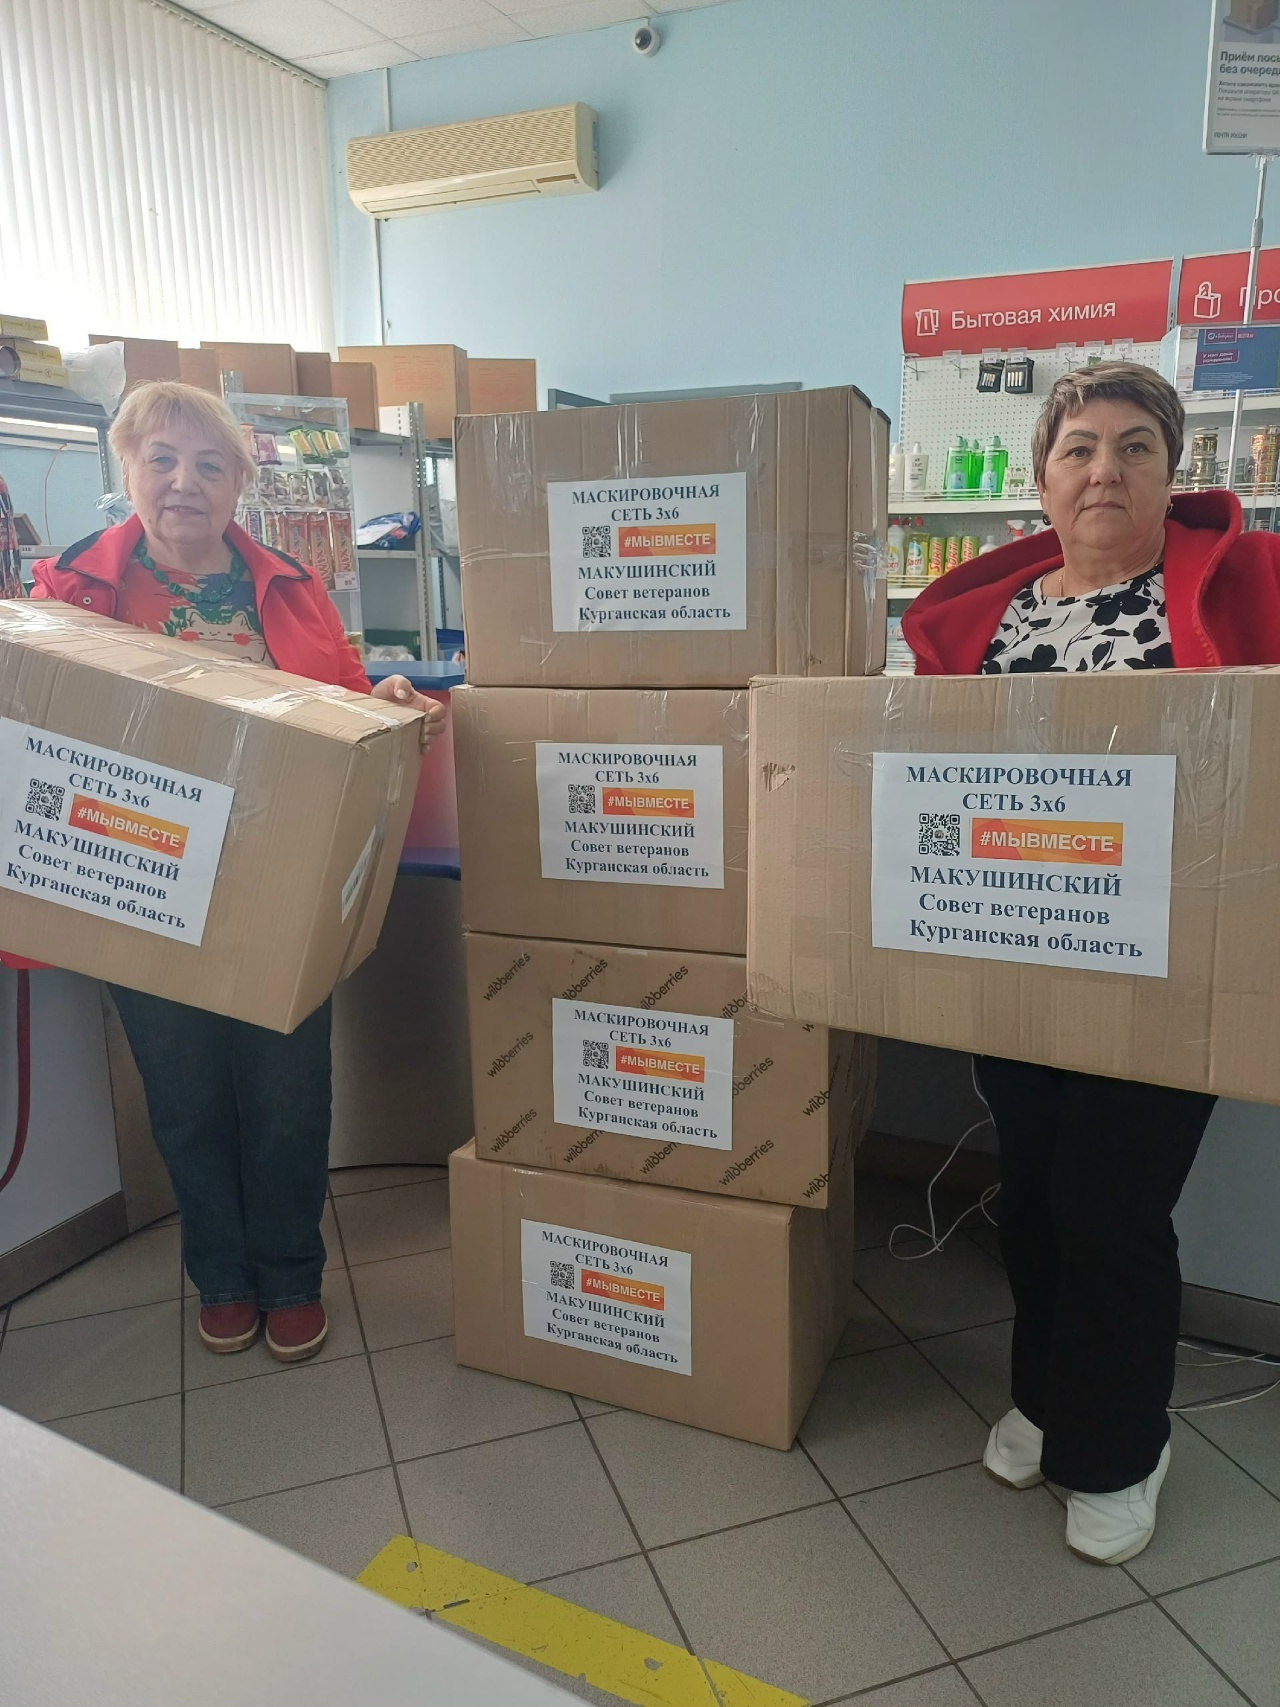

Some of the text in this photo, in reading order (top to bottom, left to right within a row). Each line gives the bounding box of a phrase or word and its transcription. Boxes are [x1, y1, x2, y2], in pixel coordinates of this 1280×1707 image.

[1221, 51, 1255, 63] Приём
[1220, 64, 1280, 77] без очеред
[952, 302, 1116, 330] Бытовая химия
[572, 485, 720, 504] МАСКИРОВОЧНАЯ
[611, 508, 652, 521] СЕТЬ
[624, 534, 710, 547] #МЫВМЕСТЕ
[578, 560, 716, 579] МАКУШИНСКИЙ
[585, 587, 710, 601] Совет ветеранов
[579, 606, 730, 623] Курганская область
[26, 737, 203, 802] МАСКИРОВОЧНАЯ
[558, 752, 696, 766] МАСКИРОВОЧНАЯ
[69, 773, 117, 799] СЕТЬ
[595, 771, 633, 782] СЕТЬ
[906, 766, 1133, 786] МАСКИРОВОЧНАЯ
[608, 797, 689, 809] #МЫВМЕСТЕ
[963, 793, 1023, 811] СЕТЬ
[77, 807, 180, 847] #МЫВМЕСТЕ
[564, 821, 694, 838] МАКУШИНСКИЙ
[14, 820, 180, 881] МАКУШИНСКИЙ
[571, 840, 689, 858] Совет ветеранов
[980, 831, 1114, 852] #МЫВМЕСТЕ
[19, 844, 167, 899] Совет ветеранов
[566, 858, 708, 877] Курганская область
[911, 866, 1122, 896] МАКУШИНСКИЙ
[7, 863, 186, 929] Курганская область
[919, 894, 1110, 925] Совет ветеранов
[910, 920, 1142, 957] Курганская область
[483, 952, 531, 1001] wildberries
[562, 959, 608, 1000] ildberries
[640, 966, 688, 1010] ildberries
[574, 1010, 709, 1036] МАСКИРОВОЧНАЯ
[610, 1030, 646, 1045] СЕТЬ
[488, 1032, 534, 1078] wildberries
[621, 1056, 699, 1074] #МЫВМЕСТЕ
[578, 1073, 704, 1101] МАКУШИНСКИЙ
[584, 1090, 698, 1118] Совет ветеранов
[491, 1108, 537, 1152] wildberries
[578, 1107, 717, 1138] Курганская область
[720, 1139, 774, 1186] wildberries
[542, 1231, 668, 1267] МАСКИРОВОЧНАЯ
[575, 1254, 610, 1269] СЕТЬ
[586, 1278, 660, 1301] #МЫВМЕСТЕ
[547, 1291, 665, 1328] МАКУШИНСКИЙ
[552, 1309, 659, 1342] Совет ветеранов
[547, 1322, 678, 1363] Курганская область
